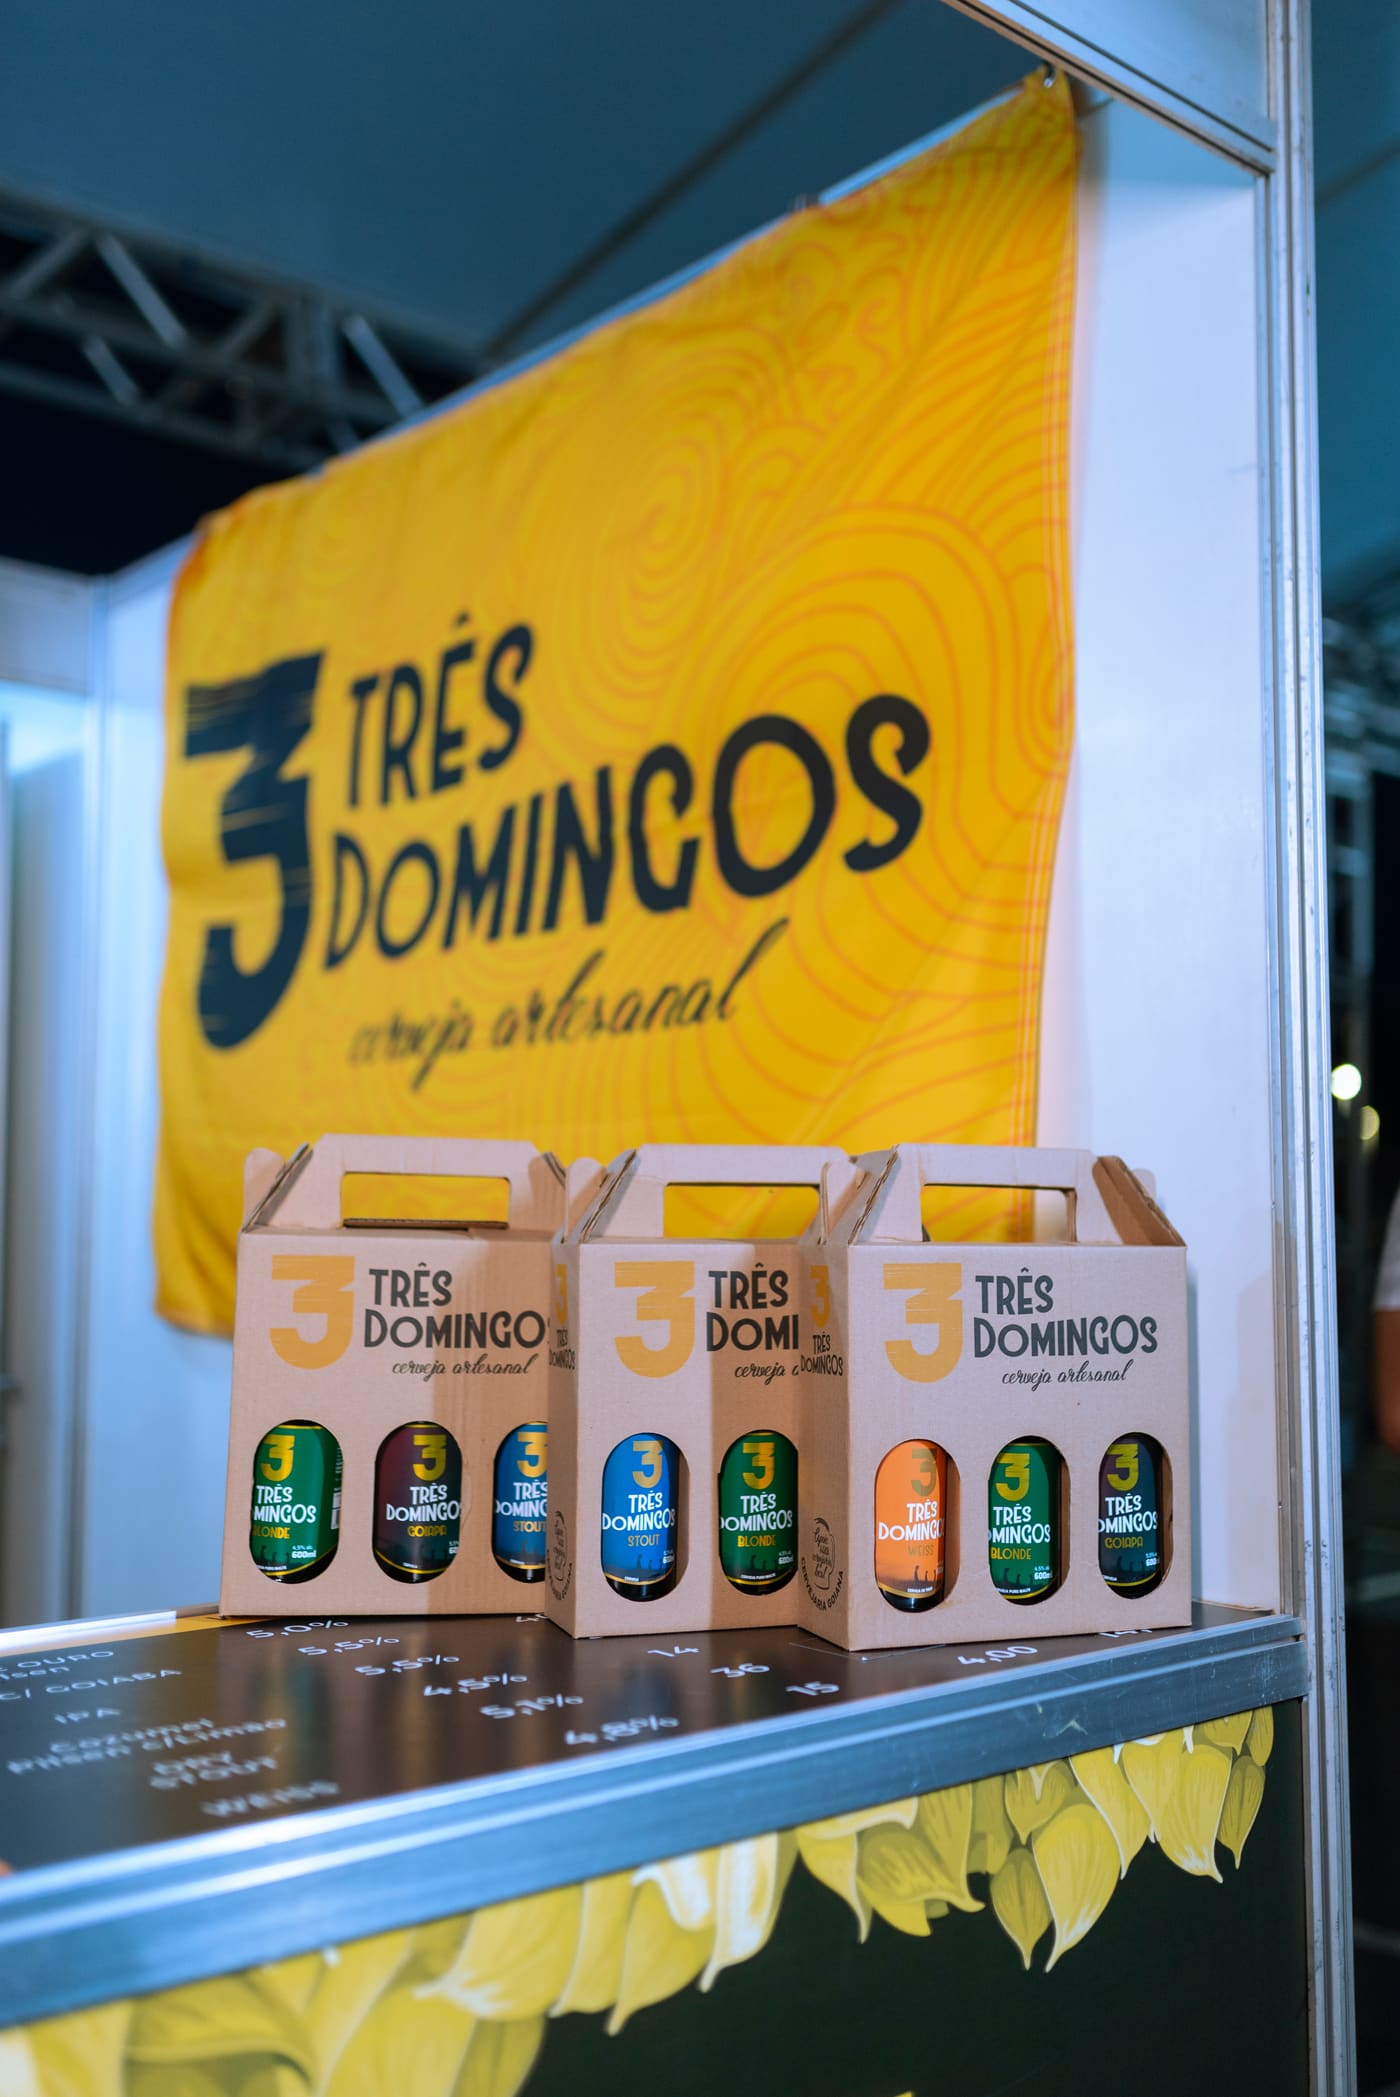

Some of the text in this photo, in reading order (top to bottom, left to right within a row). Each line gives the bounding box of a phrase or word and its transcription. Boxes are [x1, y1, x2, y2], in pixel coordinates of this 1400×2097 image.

[349, 611, 534, 810] TRÊS
[325, 693, 932, 971] DOMINGOS
[183, 648, 326, 1051] 3
[491, 918, 790, 1051] artesanal
[369, 1262, 452, 1308] TRÊS
[708, 1262, 789, 1309] TRÊS
[810, 1265, 831, 1328] 3
[975, 1267, 1053, 1315] TRÊS
[269, 1255, 355, 1370] 3
[614, 1260, 695, 1378] 3
[883, 1262, 963, 1383] 3
[364, 1309, 550, 1348] DOMINGO
[973, 1314, 1158, 1358] DOMINGOS
[392, 1353, 539, 1382] cerveja artesanal
[735, 1362, 785, 1385] cerveja
[800, 1354, 844, 1376] DOMINGOS
[1001, 1359, 1134, 1391] cerveja artesanal
[260, 1434, 295, 1482] 3
[413, 1434, 447, 1482] 3
[517, 1432, 547, 1478] 3
[632, 1440, 663, 1488] 3
[742, 1442, 774, 1490] 3
[1106, 1443, 1139, 1491] 3
[911, 1448, 937, 1497] 3
[995, 1453, 1030, 1501] 3
[256, 1483, 293, 1504] TRÊS
[410, 1483, 447, 1505] TRÊS
[628, 1490, 663, 1513] TRÊS
[740, 1491, 776, 1514] TRÊS
[1105, 1493, 1142, 1516] TRÊS
[386, 1500, 461, 1522] DOMINGO
[602, 1508, 675, 1531] DOMINGOS
[906, 1498, 937, 1523] TRÊS
[993, 1503, 1032, 1526] TRÊS
[627, 1534, 660, 1547] STOUT
[737, 1535, 776, 1547] BLONDE
[991, 1546, 1032, 1560] BLONDE
[246, 1620, 349, 1638] 5,0%
[17, 1651, 114, 1668] OURO
[297, 1636, 400, 1655] 5,5%
[648, 1645, 700, 1658] 14
[354, 1654, 460, 1676] 5,5%
[709, 1662, 770, 1678] 36
[423, 1672, 528, 1696] 4,5%
[785, 1680, 840, 1696] 15
